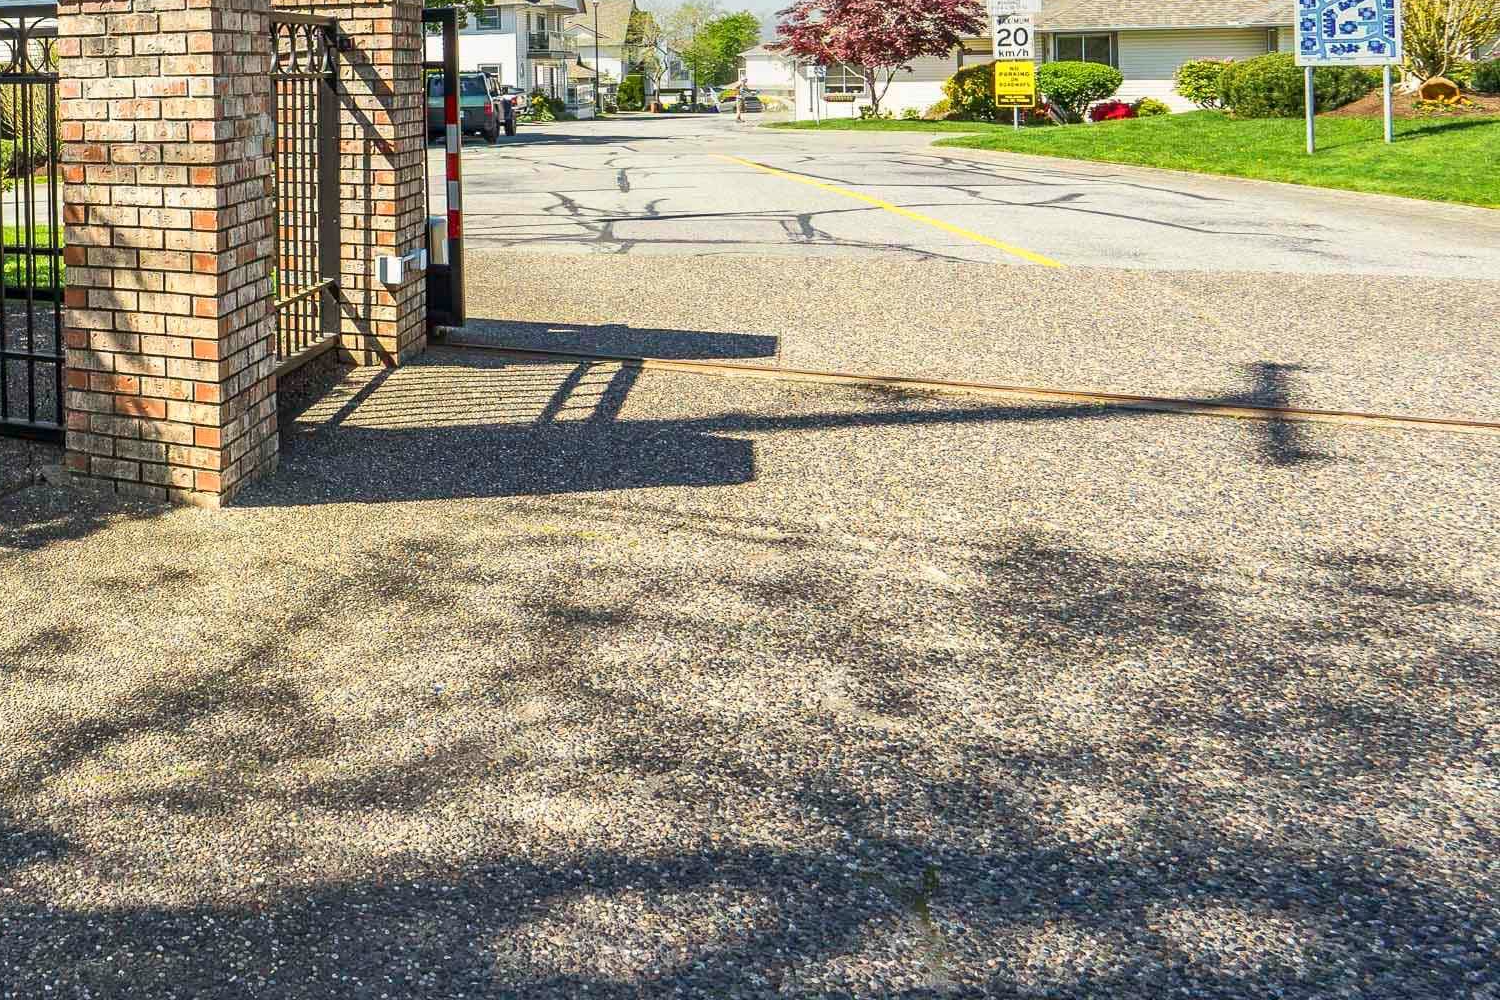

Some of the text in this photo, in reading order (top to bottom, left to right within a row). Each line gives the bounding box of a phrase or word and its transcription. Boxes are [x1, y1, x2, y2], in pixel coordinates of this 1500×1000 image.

[997, 16, 1030, 24] AXIMUM
[997, 27, 1028, 46] 20
[998, 49, 1029, 57] km/h
